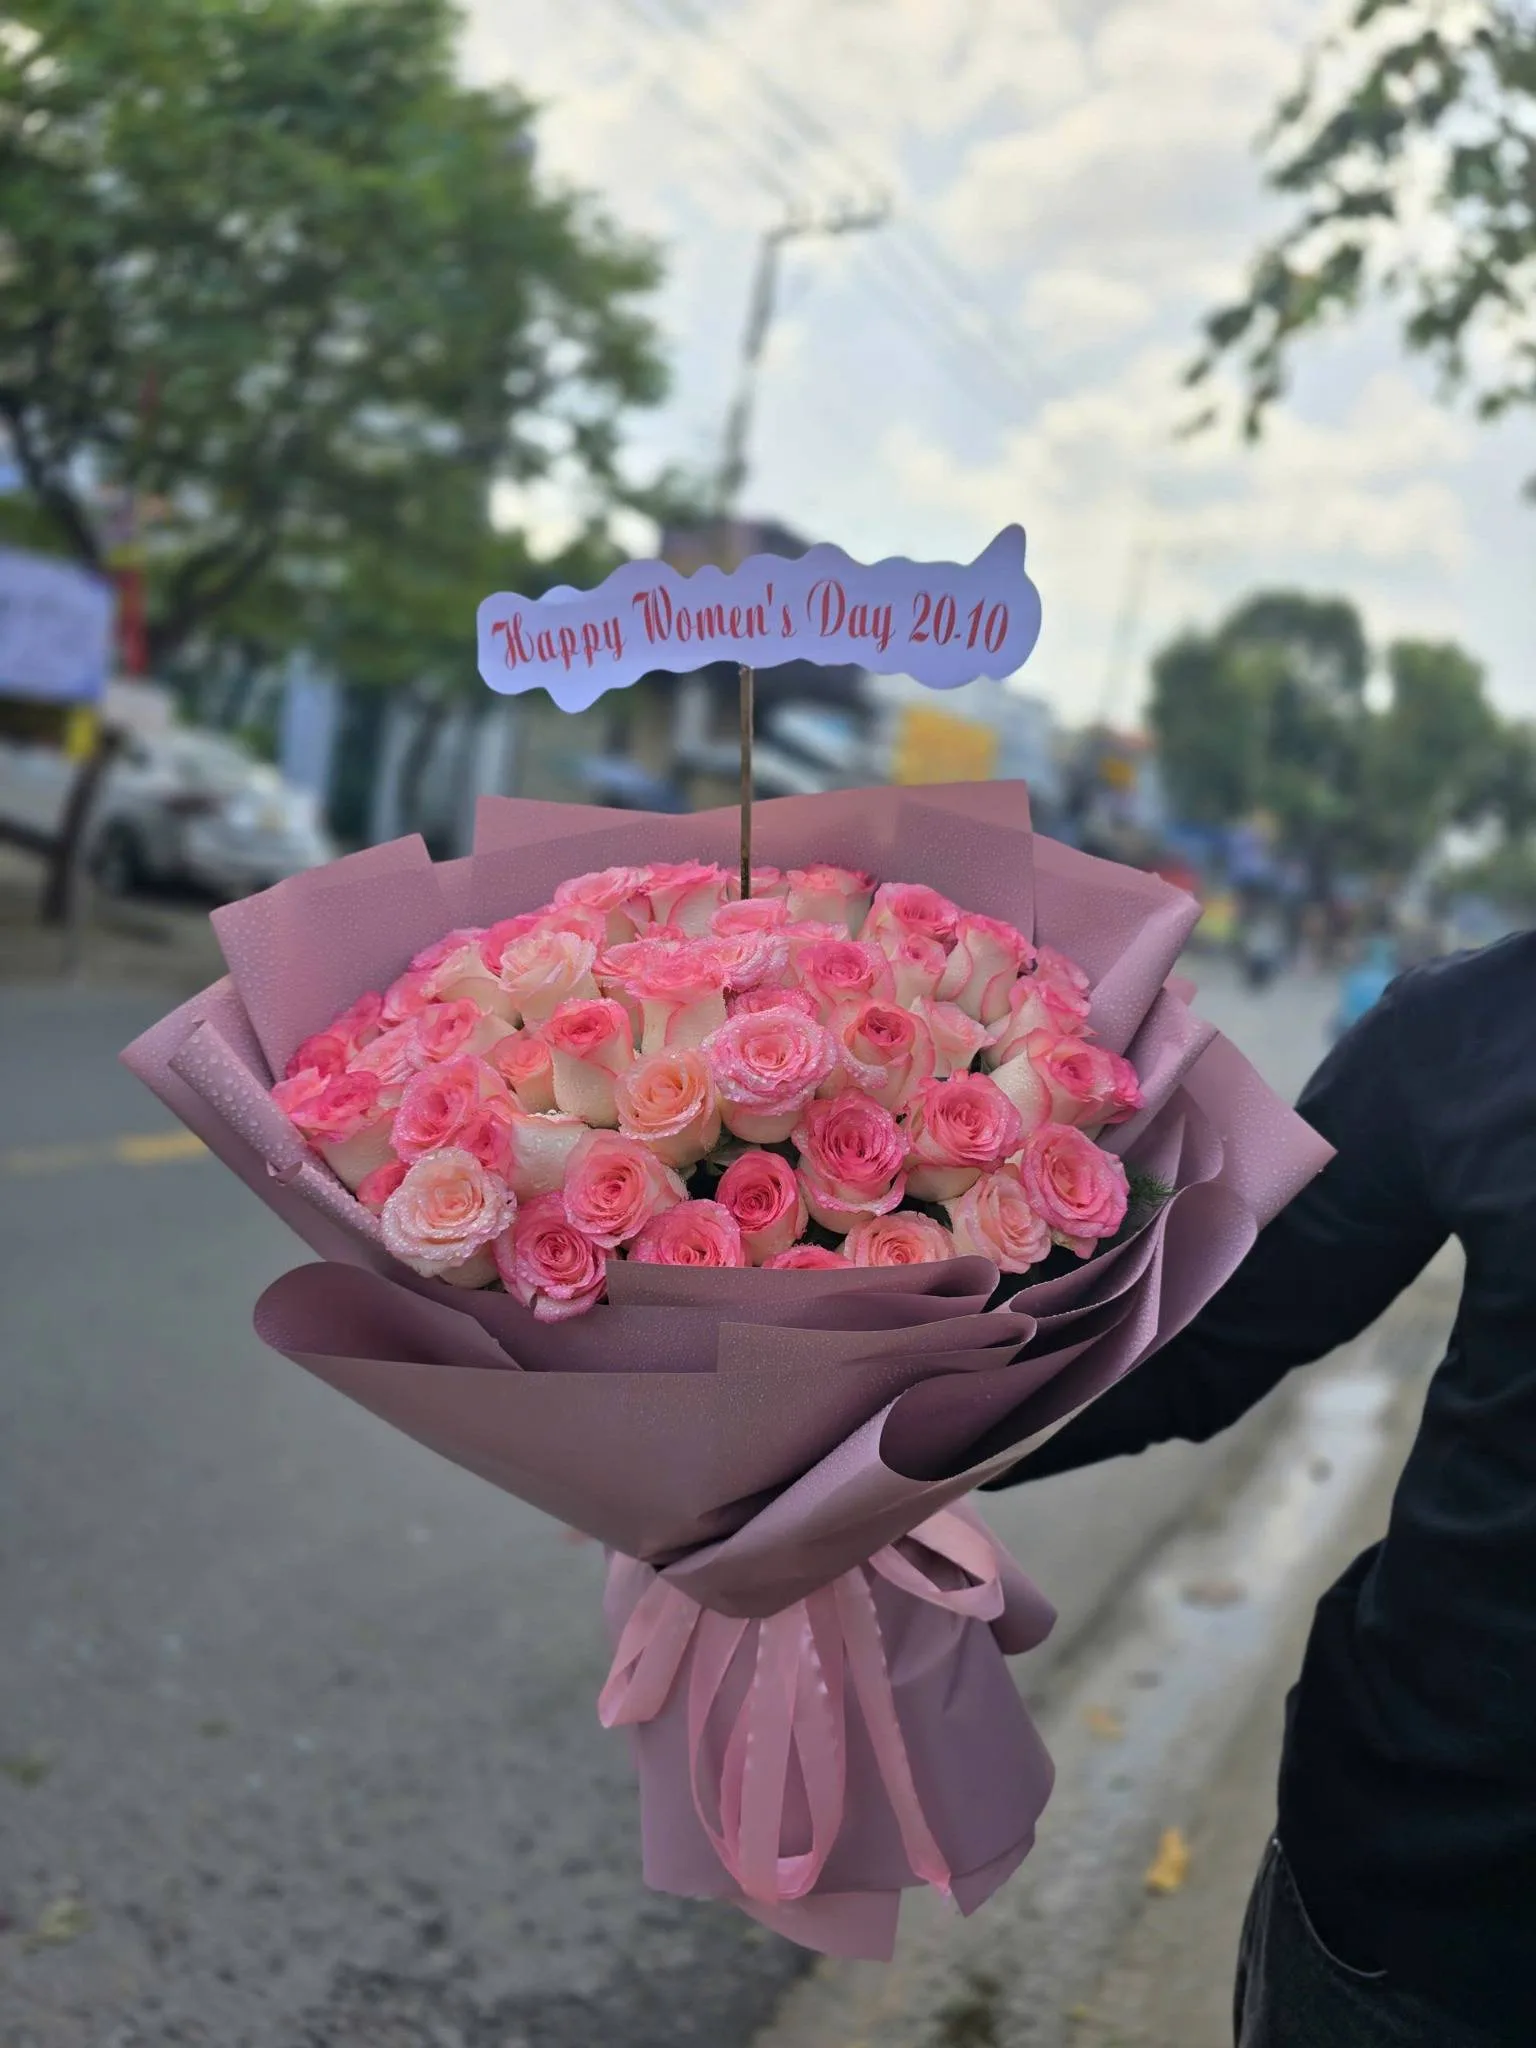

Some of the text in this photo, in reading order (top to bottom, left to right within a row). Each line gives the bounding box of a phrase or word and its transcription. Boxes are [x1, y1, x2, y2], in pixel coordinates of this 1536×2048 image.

[491, 579, 1009, 671] Happy Women's Day 20.10
